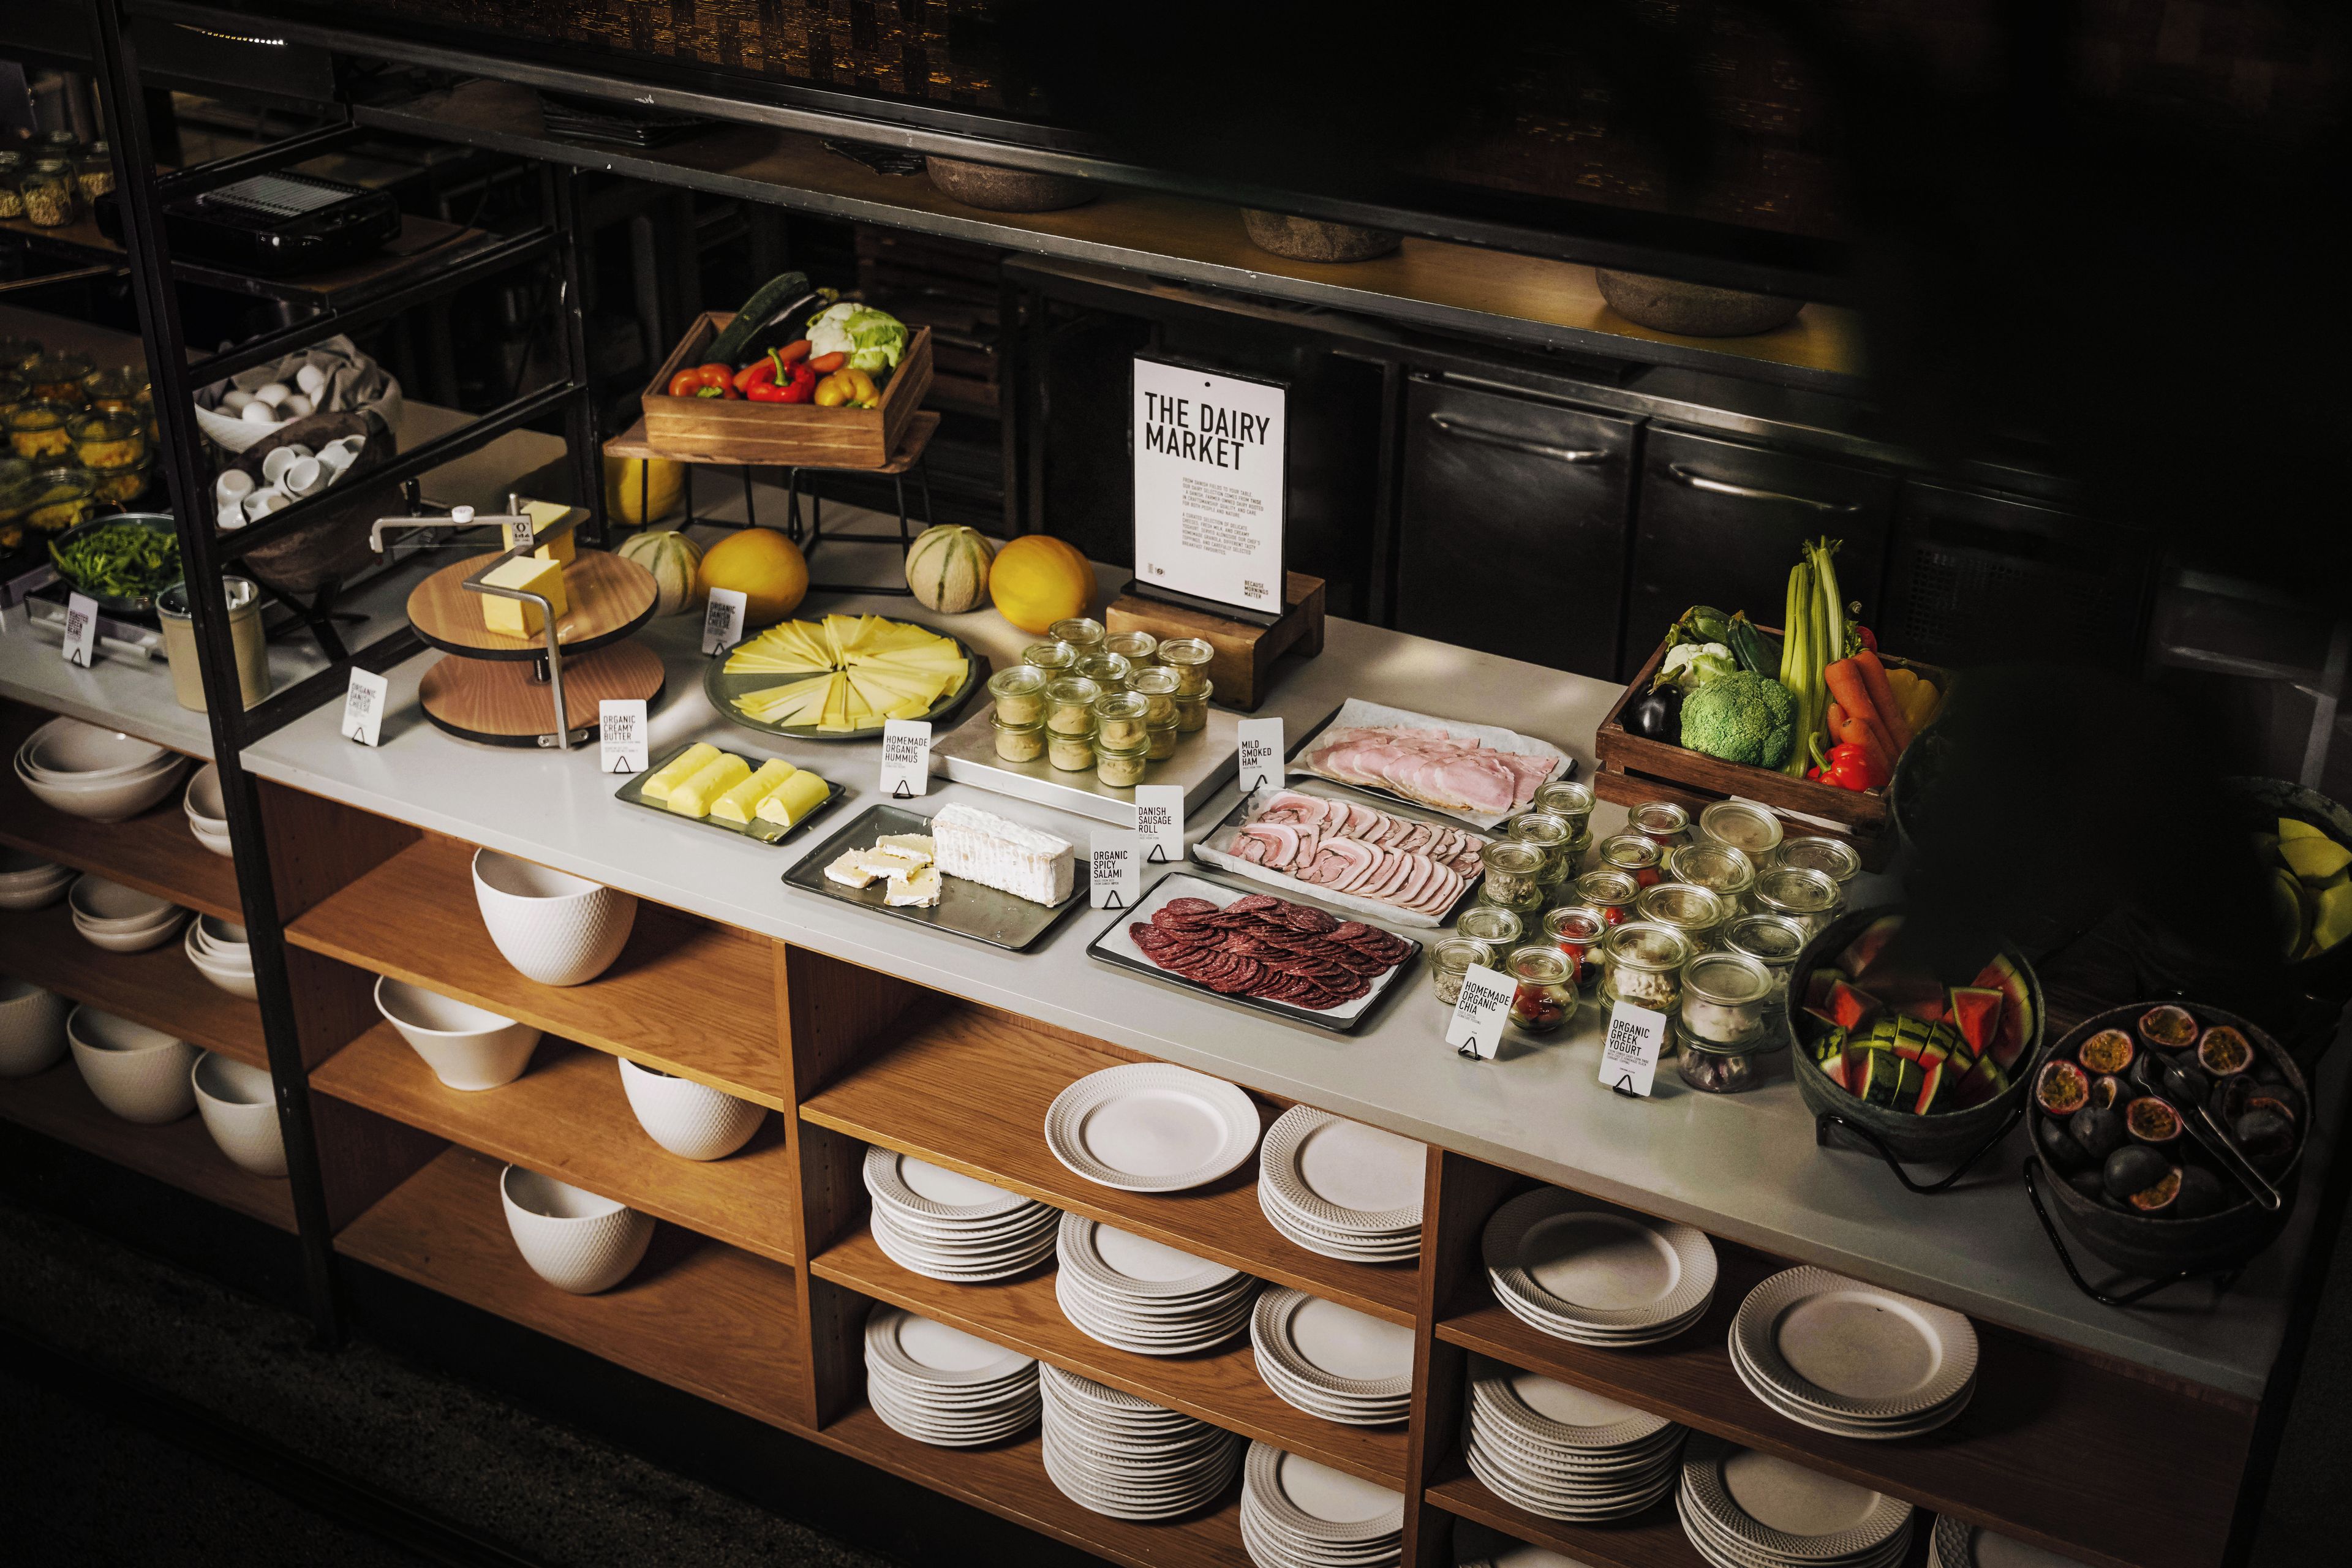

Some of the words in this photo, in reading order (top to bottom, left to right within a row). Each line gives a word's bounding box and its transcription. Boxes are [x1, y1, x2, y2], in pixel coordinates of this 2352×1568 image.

[1145, 391, 1189, 428] THE
[1200, 403, 1270, 445] DAIRY
[1146, 422, 1244, 470] MARKET
[1204, 488, 1223, 497] SELECTION
[1201, 504, 1215, 513] PEOPLE
[1231, 523, 1247, 532] DELICATE
[1232, 546, 1251, 555] SELECTED
[1245, 580, 1264, 589] BECAUSE
[1245, 586, 1269, 595] MORNINGS
[352, 682, 377, 699] ORGANIC
[886, 735, 928, 747] HOMEMADE
[1242, 740, 1259, 749] MILD
[886, 744, 918, 755] ORGANIC
[1242, 747, 1272, 758] SMOKED
[885, 753, 918, 763] HUMMUS
[1242, 757, 1257, 766] HAM
[1139, 807, 1166, 815] DANISH
[1139, 816, 1172, 824] SAUSAGE
[1139, 824, 1158, 833] ROLL
[1094, 850, 1128, 860] ORGANIC
[1094, 861, 1116, 869] SPICY
[1094, 869, 1122, 878] SALAMI
[1464, 981, 1510, 1006] HOMEMADE
[1462, 990, 1497, 1011] ORGANIC
[1459, 1000, 1477, 1014] CHIA
[1613, 1019, 1650, 1038] ORGANIC
[1611, 1029, 1638, 1046] GREEK
[1610, 1038, 1642, 1056] YOGURT
